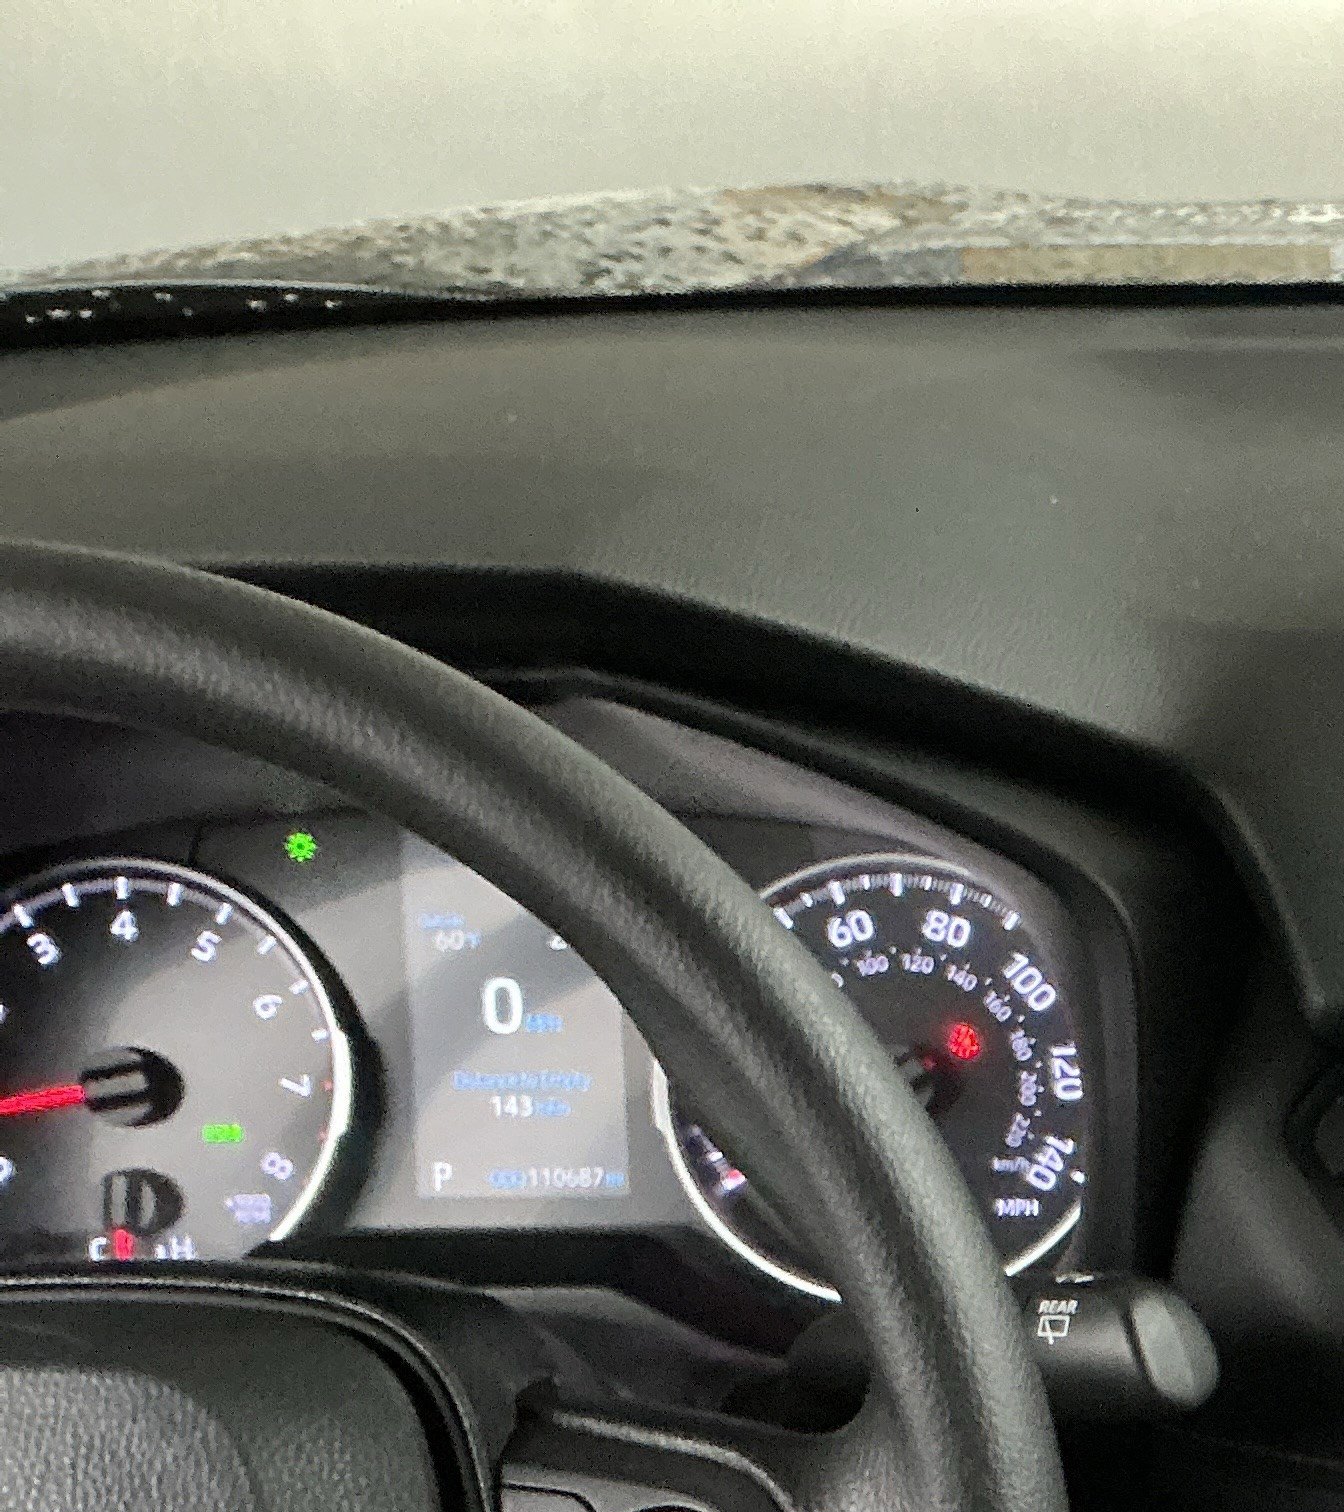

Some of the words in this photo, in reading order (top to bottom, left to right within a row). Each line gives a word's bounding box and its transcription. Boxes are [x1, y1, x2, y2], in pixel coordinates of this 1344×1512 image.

[110, 910, 139, 942] 4
[827, 909, 876, 948] 60
[922, 909, 971, 948] 80
[27, 933, 61, 966] 3
[190, 930, 222, 962] 5
[902, 953, 935, 975] 120
[947, 963, 978, 992] 140
[1002, 951, 1056, 1011] 100
[252, 994, 283, 1020] 6
[482, 976, 523, 1035] 0
[278, 1073, 311, 1097] 7
[1050, 1042, 1084, 1101] 120
[260, 1151, 294, 1180] 8
[434, 1161, 452, 1192] P
[1026, 1134, 1076, 1191] 140
[995, 1198, 1040, 1217] MPH
[1038, 1299, 1079, 1315] REAR
